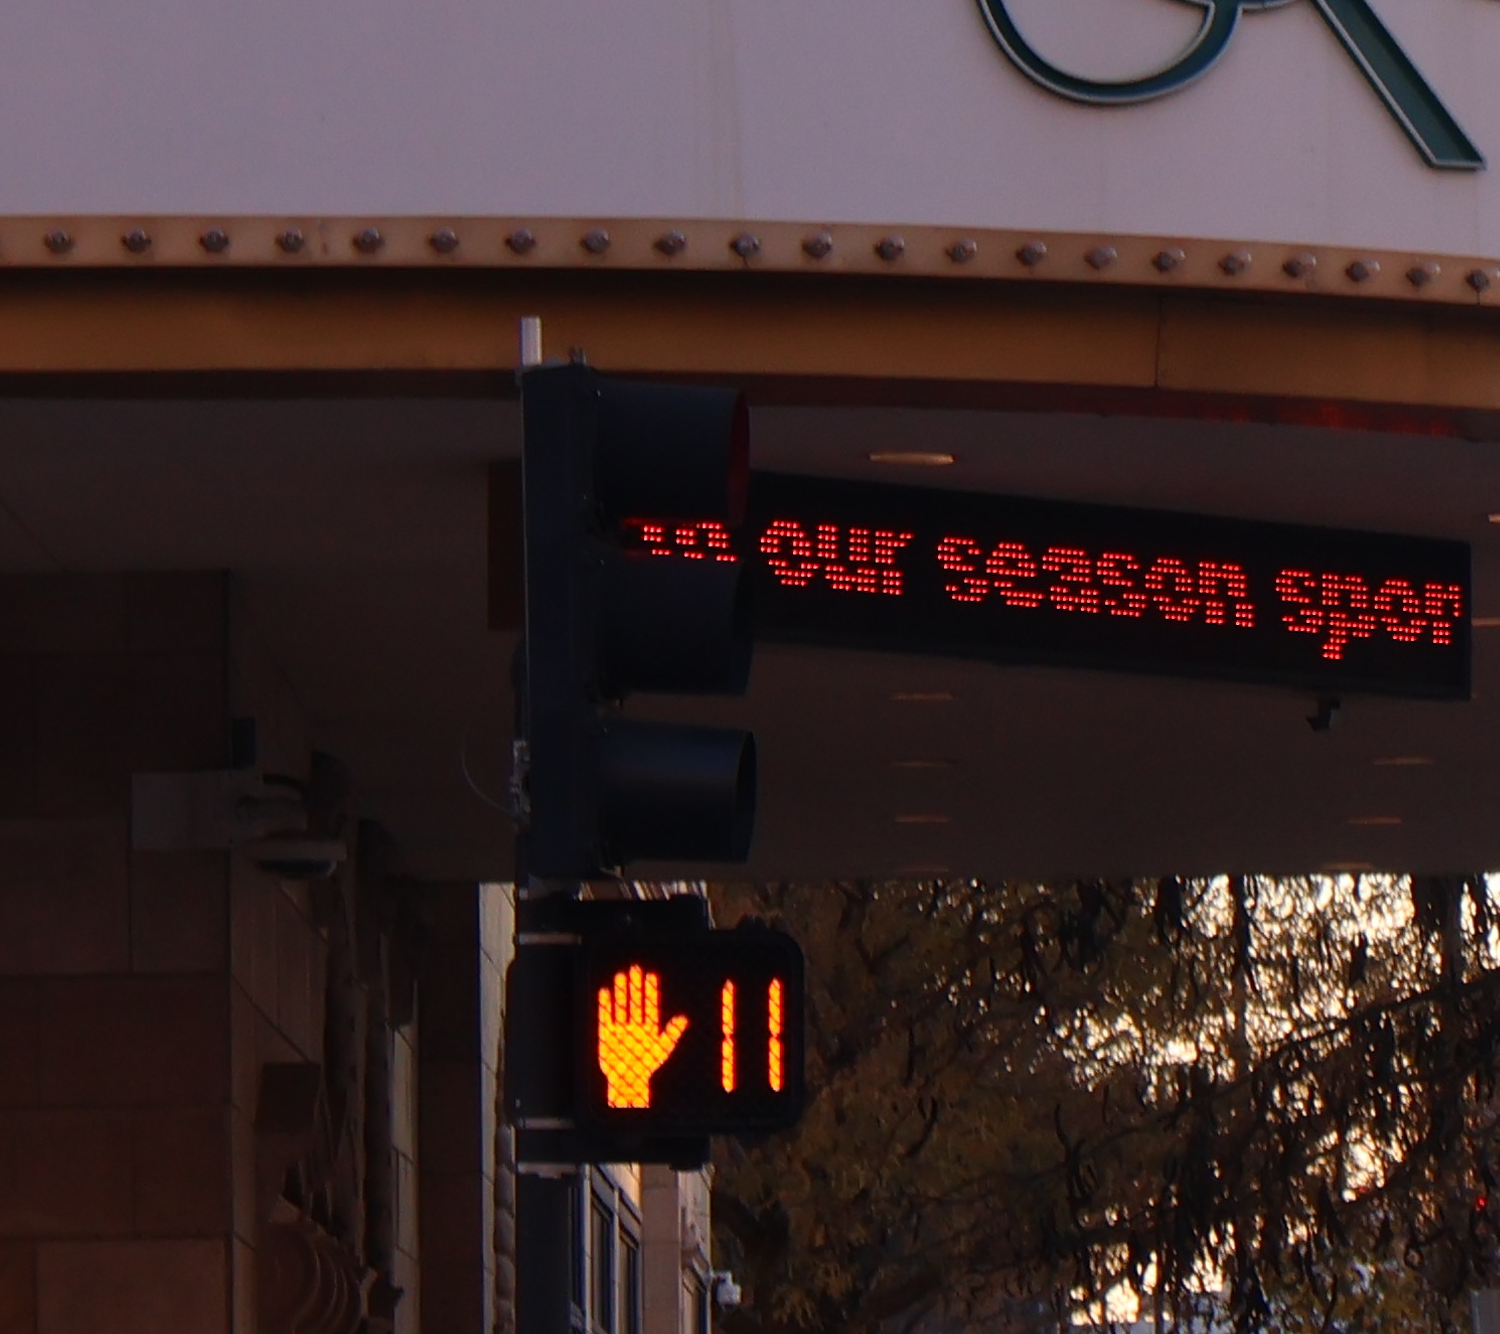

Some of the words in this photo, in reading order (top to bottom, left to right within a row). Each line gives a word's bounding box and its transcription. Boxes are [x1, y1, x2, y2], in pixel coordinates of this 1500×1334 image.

[760, 520, 915, 595] our
[936, 535, 1256, 630] season
[722, 977, 784, 1094] 11
